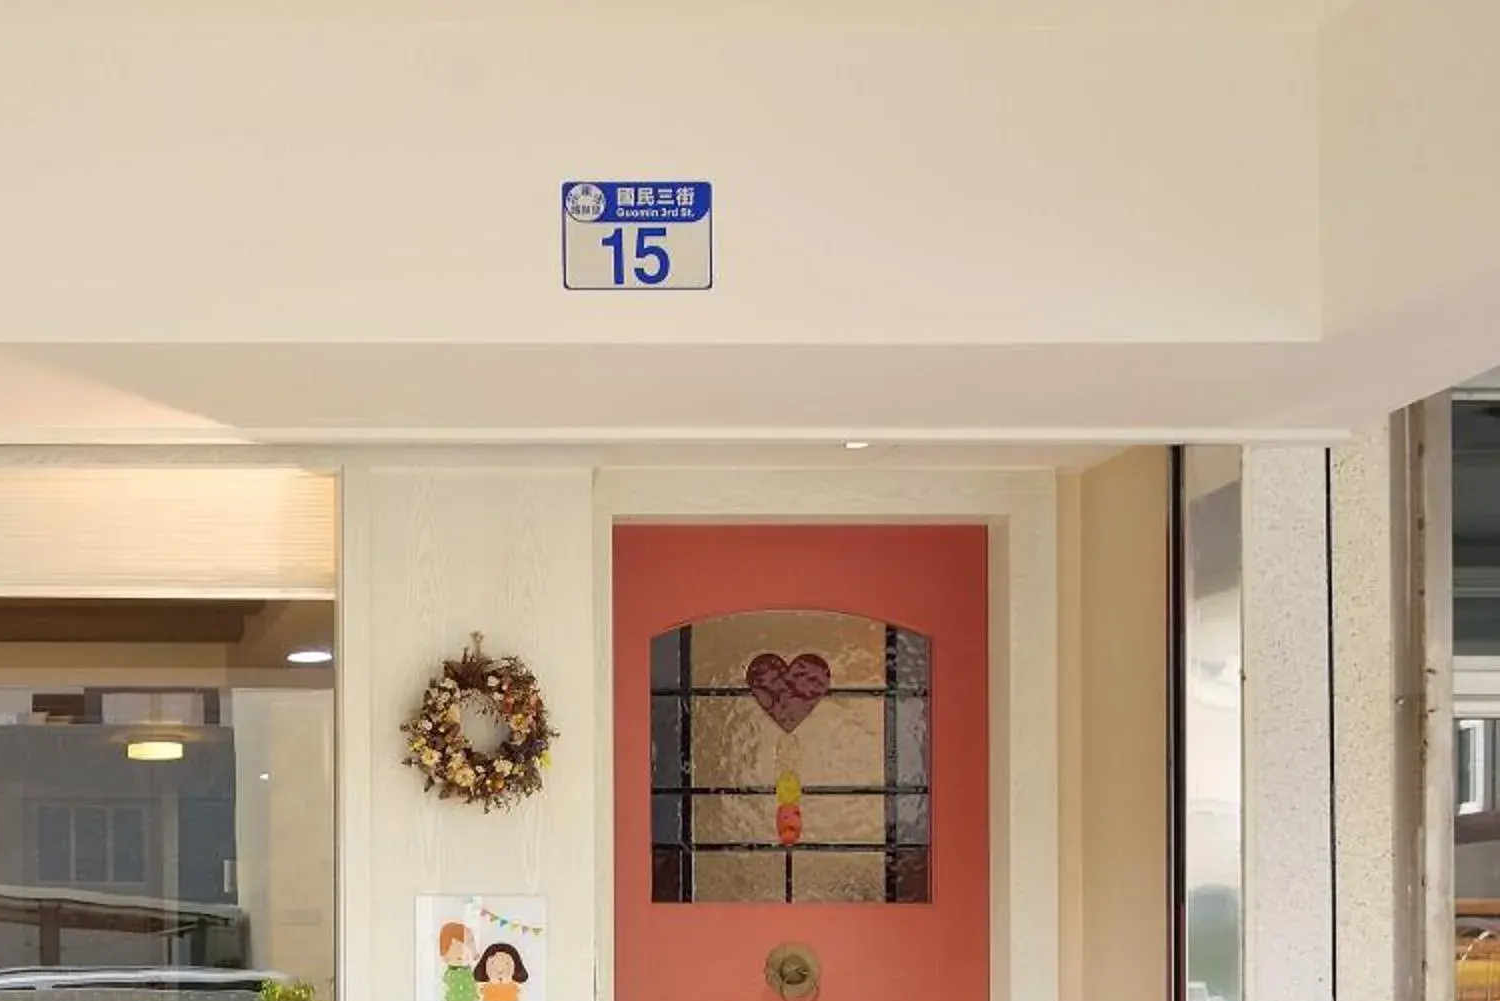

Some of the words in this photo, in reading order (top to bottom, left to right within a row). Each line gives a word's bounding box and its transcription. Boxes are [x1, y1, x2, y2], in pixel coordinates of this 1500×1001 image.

[617, 186, 695, 206] 國民三街
[661, 207, 679, 217] 3rd
[680, 207, 695, 217] St.
[601, 227, 671, 286] 15
